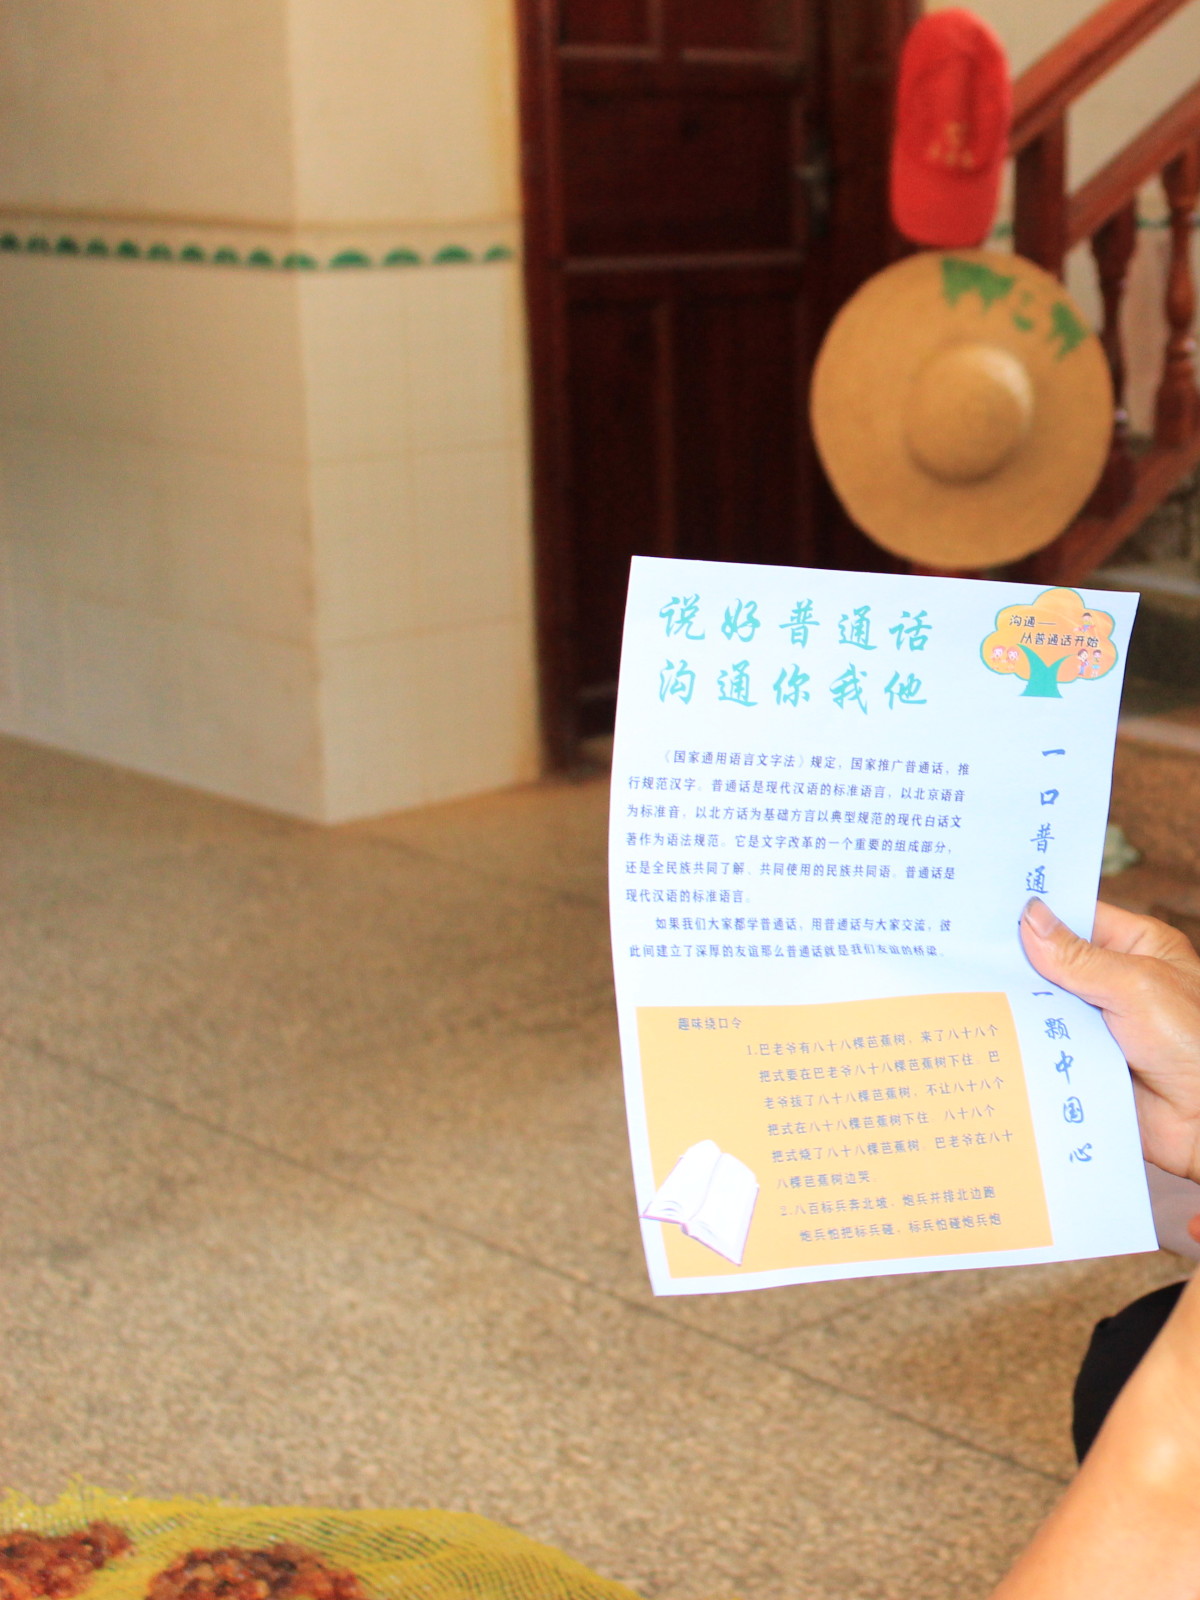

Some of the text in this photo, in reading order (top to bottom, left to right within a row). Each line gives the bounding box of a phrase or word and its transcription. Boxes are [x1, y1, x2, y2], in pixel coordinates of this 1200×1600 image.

[658, 593, 934, 652] 说好普通话
[1020, 632, 1099, 648] 从普通话开始
[658, 658, 928, 716] 沟通你我他
[1019, 747, 1067, 926] 一口普通
[625, 888, 751, 904] 现代汉语的标准语言。
[677, 1016, 742, 1032] 趣味绕口令
[1031, 989, 1095, 1164] 一颗中国心
